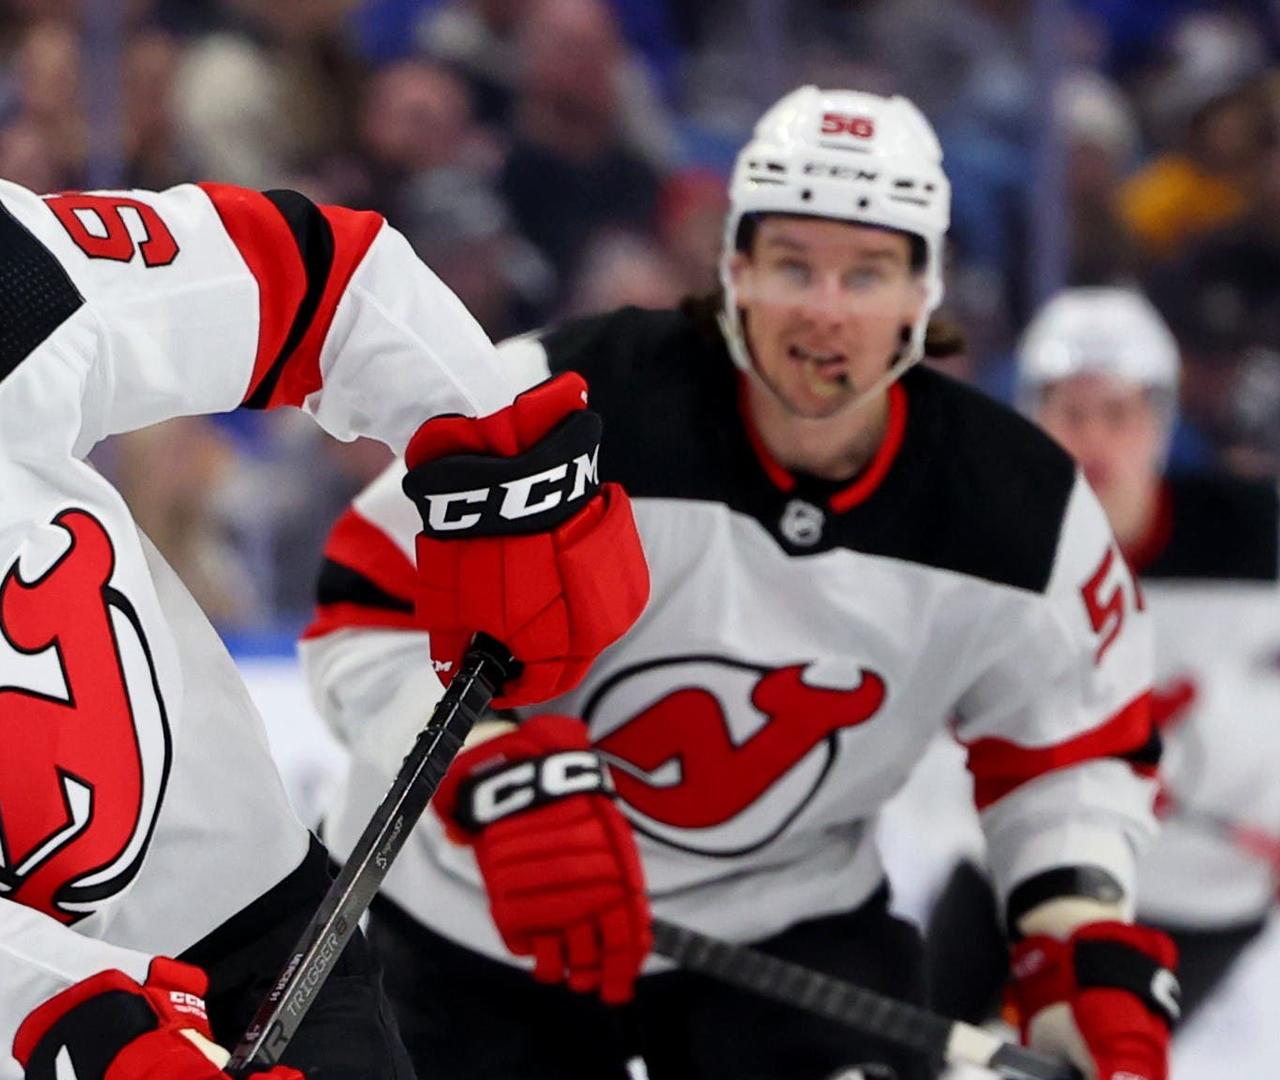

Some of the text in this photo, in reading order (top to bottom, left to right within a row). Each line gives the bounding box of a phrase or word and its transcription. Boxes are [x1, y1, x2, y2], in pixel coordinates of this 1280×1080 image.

[821, 112, 874, 138] 56
[42, 190, 180, 268] 9
[423, 442, 600, 531] CCM
[1081, 546, 1147, 666] 5
[473, 752, 606, 824] CC
[286, 932, 339, 1016] TRIGGER
